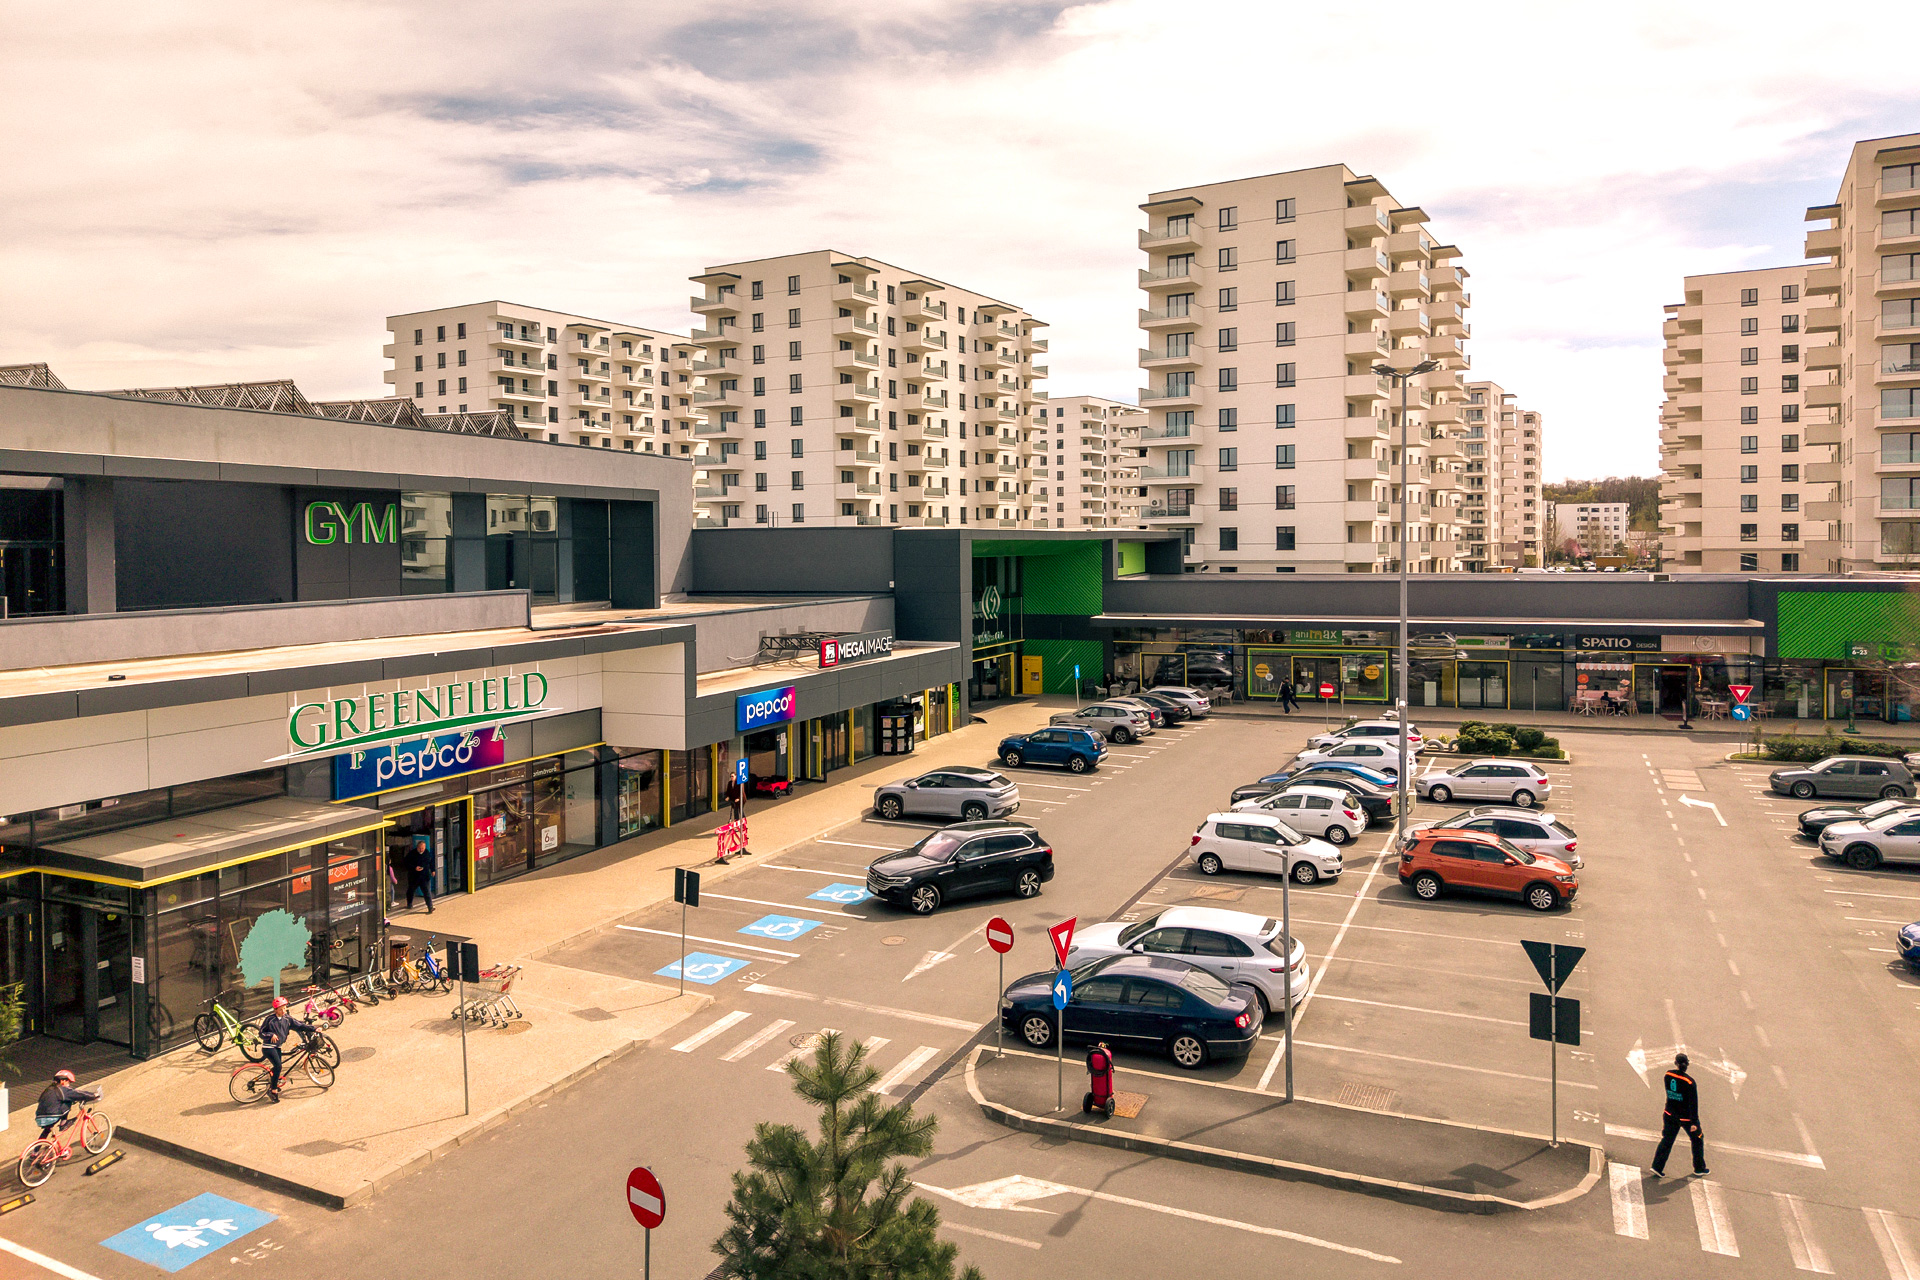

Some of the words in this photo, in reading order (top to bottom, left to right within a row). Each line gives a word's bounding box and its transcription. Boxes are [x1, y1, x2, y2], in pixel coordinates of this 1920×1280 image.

[305, 501, 396, 545] GYM
[838, 640, 865, 659] MEGA
[865, 636, 892, 654] IMAGE
[1582, 637, 1631, 648] SPATIO
[289, 672, 548, 748] GREENFIELD
[746, 699, 789, 723] pepco
[376, 741, 473, 787] pepco
[739, 761, 746, 776] P
[475, 829, 481, 839] 2
[486, 825, 491, 836] 1
[544, 833, 550, 843] 6
[338, 900, 365, 912] GREENFIELD
[813, 930, 839, 941] 121
[737, 971, 767, 984] 122
